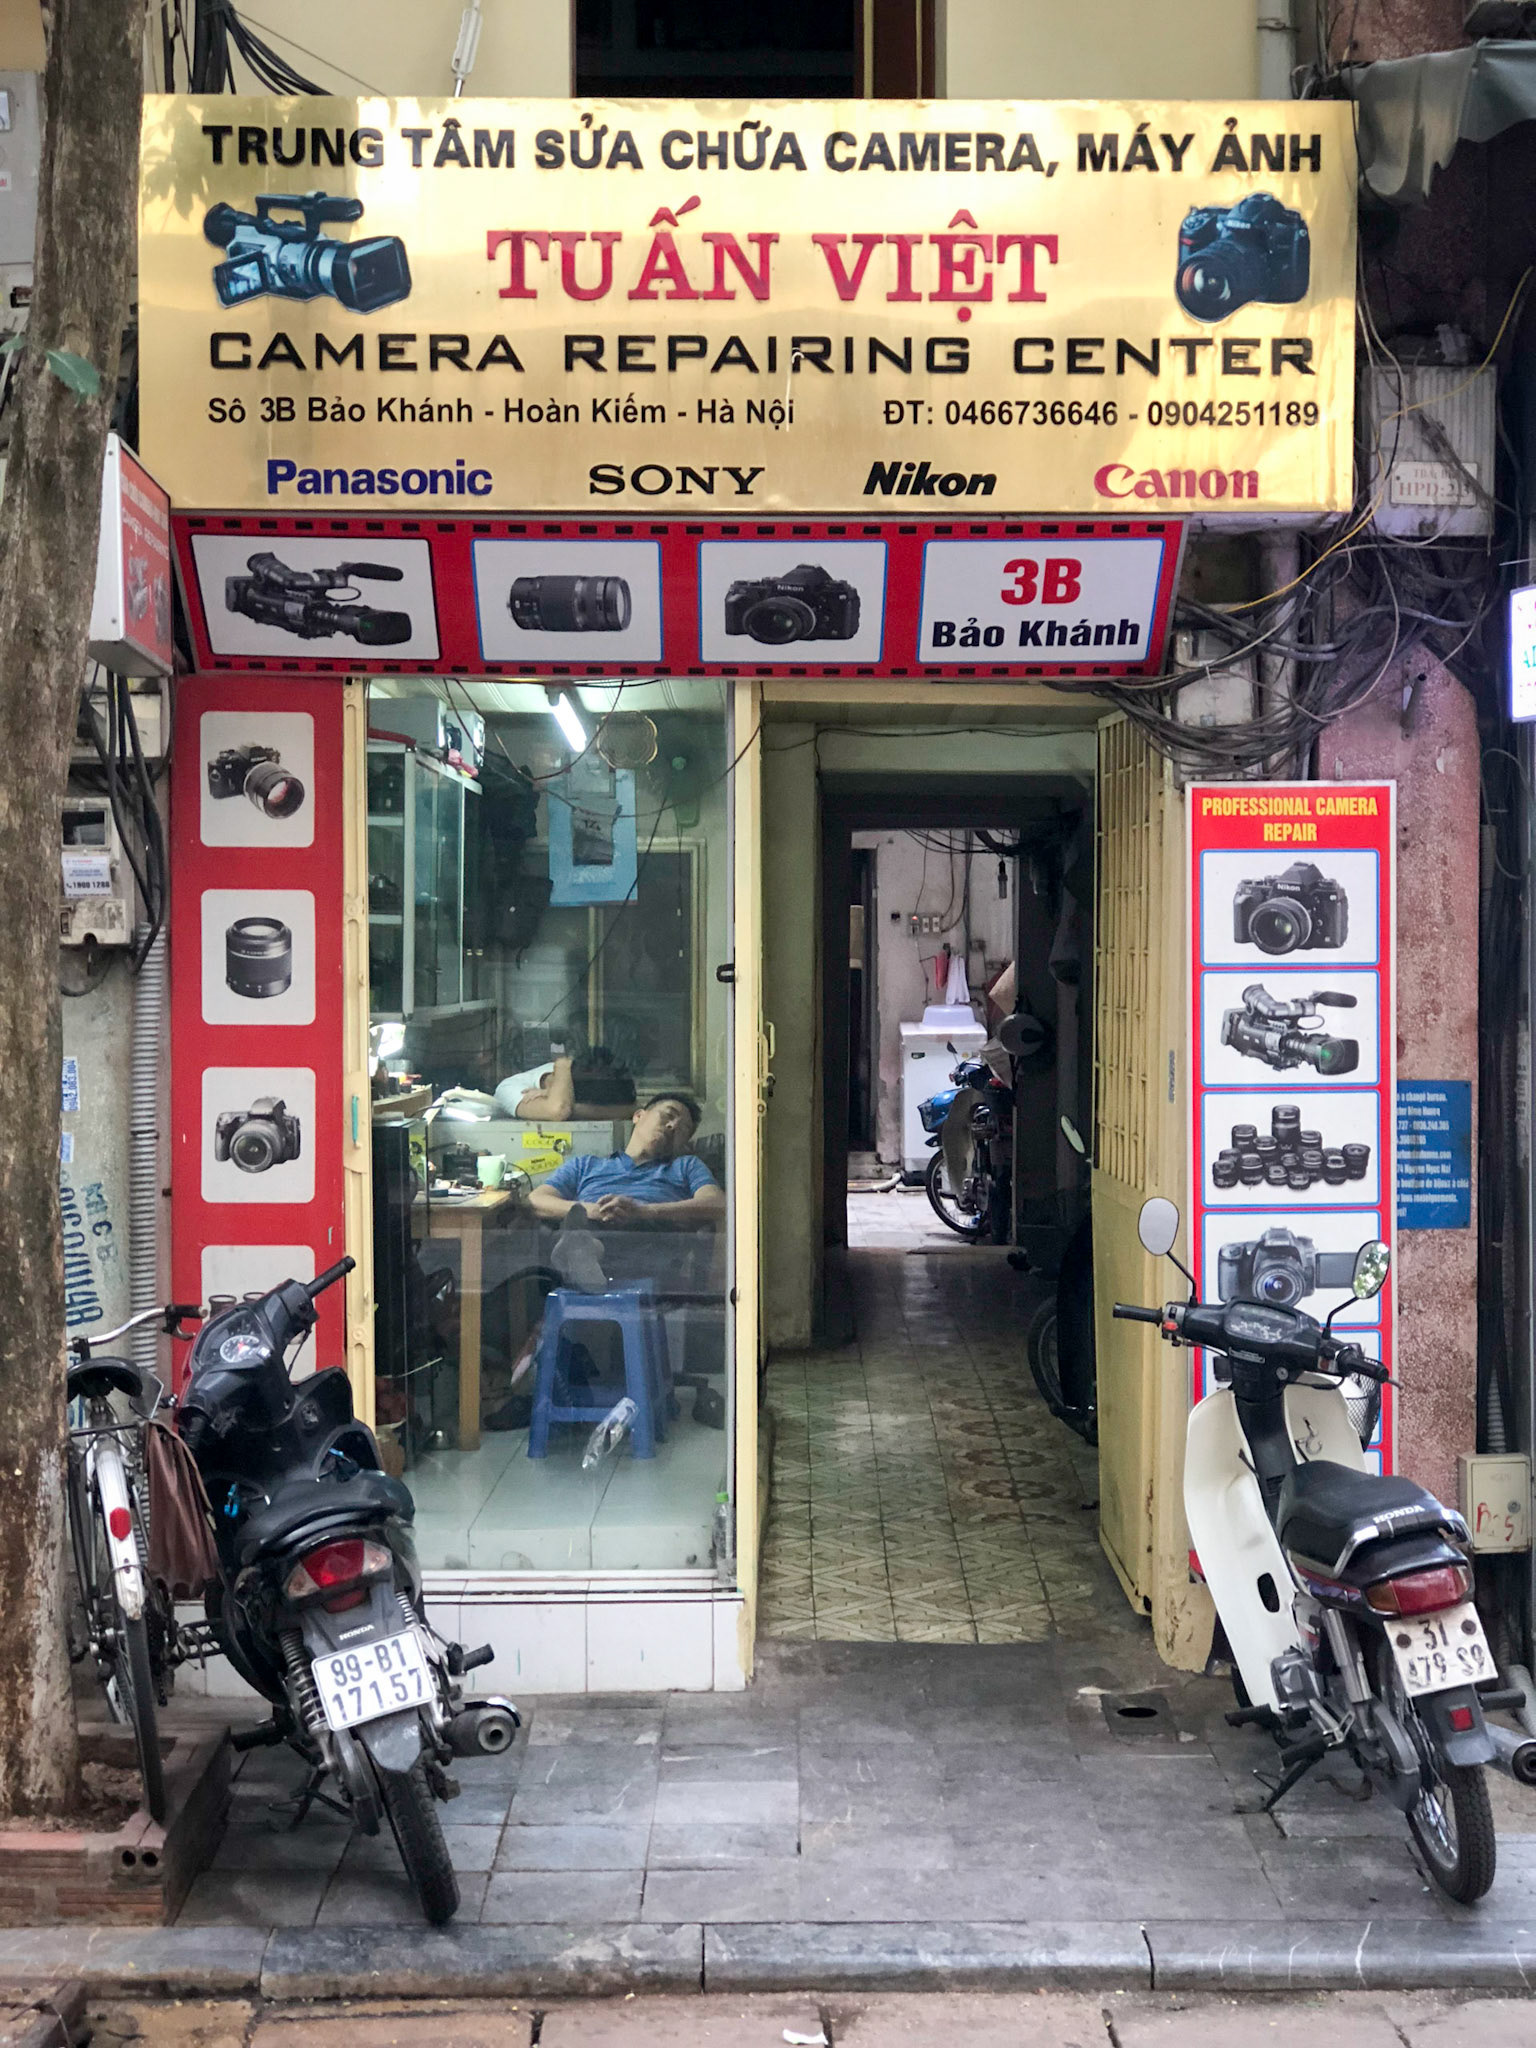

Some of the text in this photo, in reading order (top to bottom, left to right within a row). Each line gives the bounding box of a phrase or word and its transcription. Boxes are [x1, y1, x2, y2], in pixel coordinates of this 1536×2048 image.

[202, 113, 1322, 178] TRUNG TÂM SỬA CHỮA CAMERA, MÁY ẢNH
[487, 195, 1059, 322] TUẤN VIỆT
[210, 332, 1318, 376] CAMERA REPAIRING CENTER
[260, 397, 296, 422] 3B
[308, 396, 366, 422] Bảo
[377, 397, 472, 422] Khánh
[504, 398, 580, 423] Hoàn
[592, 392, 666, 423] Kiếm
[697, 398, 734, 423] Hà
[747, 399, 794, 430] Nội
[883, 401, 934, 425] ĐT:
[945, 401, 1118, 425] 0466736646
[1147, 401, 1319, 426] 0904251189
[267, 459, 493, 496] Panasonic
[589, 464, 765, 495] SONY
[863, 461, 997, 496] Nikon
[1094, 463, 1259, 499] Canon
[1000, 558, 1083, 606] 3B
[932, 617, 1140, 649] Bảo Khánh
[1202, 797, 1378, 816] PROFESSIONAL CAMERA
[1263, 823, 1317, 842] REPAIR
[1373, 1504, 1425, 1524] HONDA
[339, 1624, 375, 1641] HONDA
